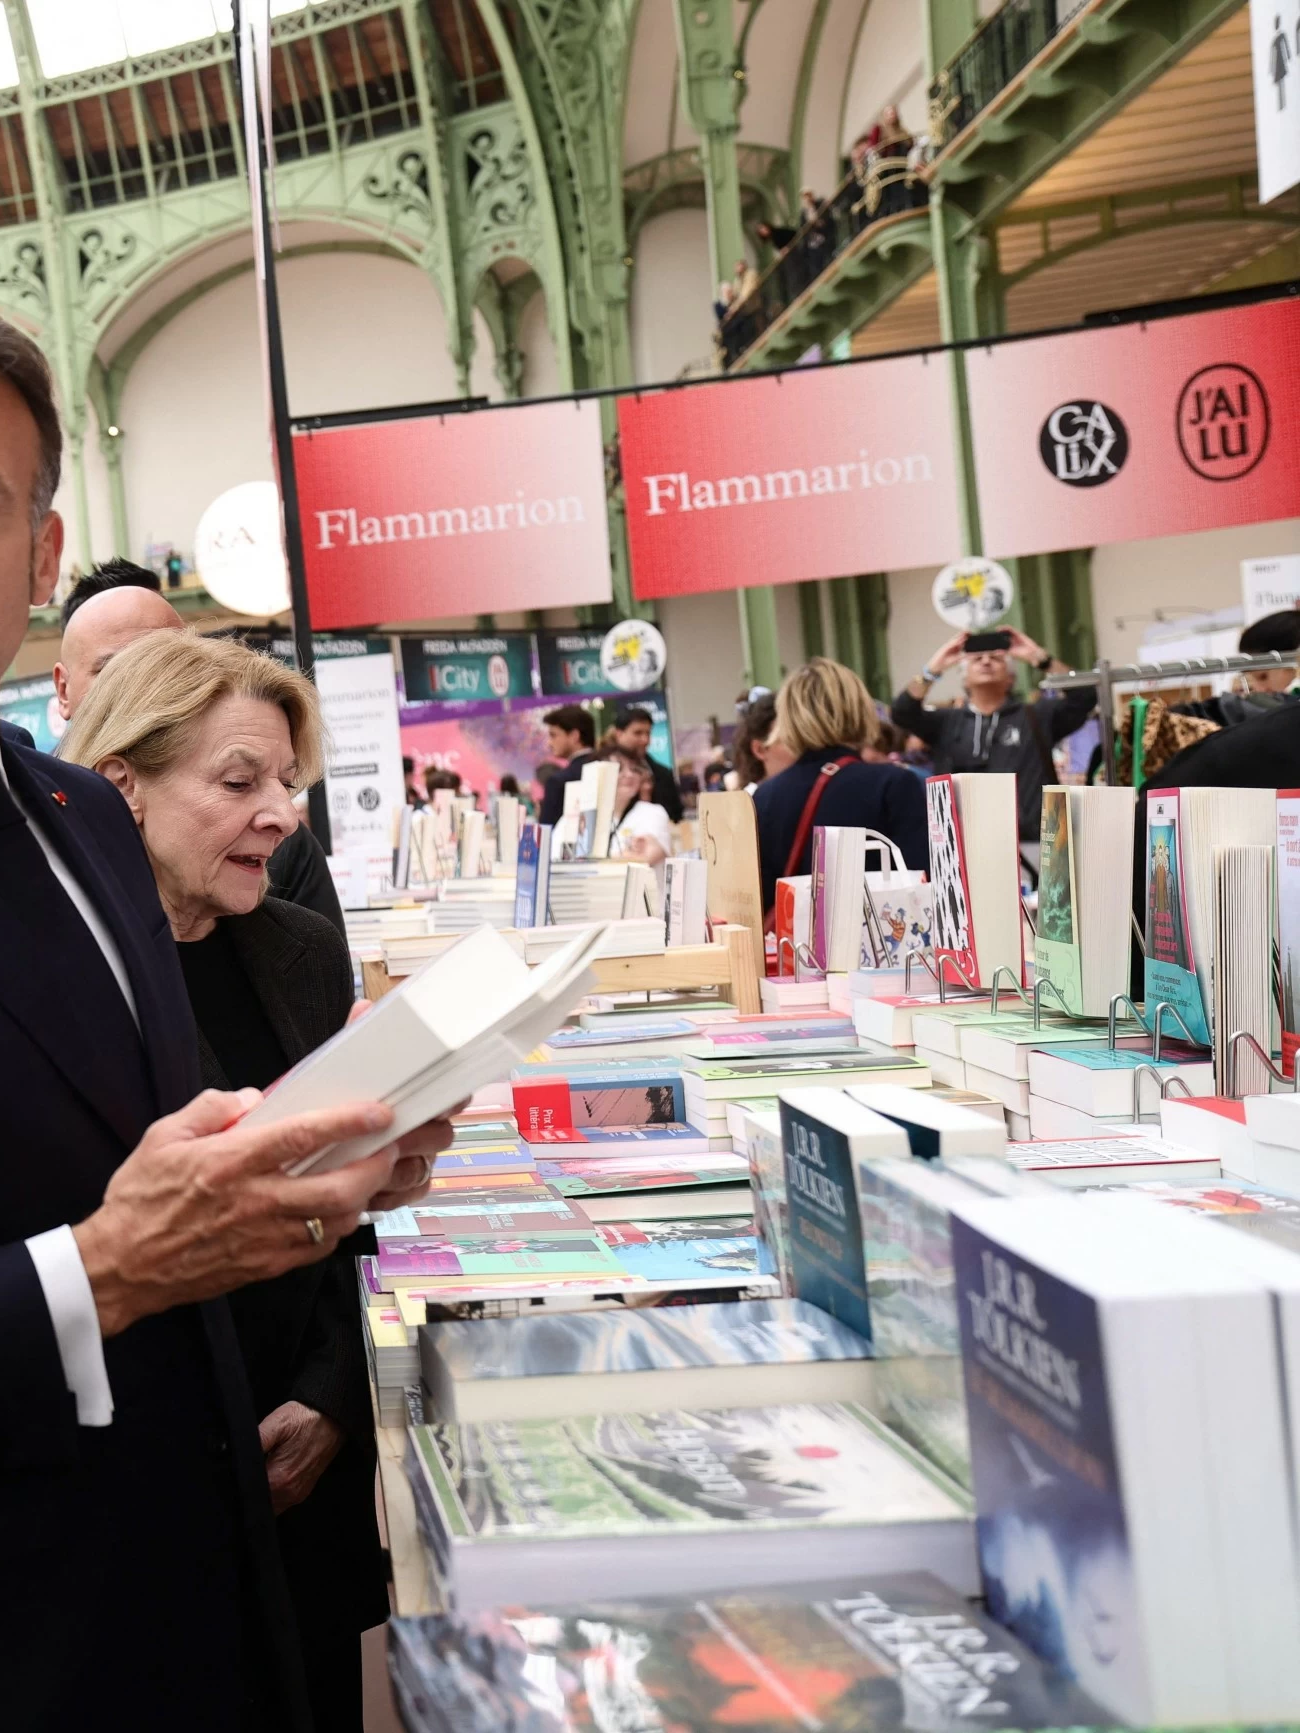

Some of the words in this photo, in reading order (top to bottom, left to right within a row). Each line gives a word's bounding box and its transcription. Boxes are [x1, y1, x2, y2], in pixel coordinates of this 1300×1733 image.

[1189, 382, 1249, 425] J'AI
[1199, 422, 1249, 461] LU
[645, 449, 933, 517] Flammarion
[316, 490, 586, 549] Flammarion
[441, 664, 480, 692] City
[529, 1106, 539, 1130] littéra
[542, 1108, 554, 1126] Prix
[785, 1152, 847, 1218] TOLKIEN
[967, 1289, 1083, 1410] TOLKIEN
[833, 1591, 1011, 1716] TOLKIEN
